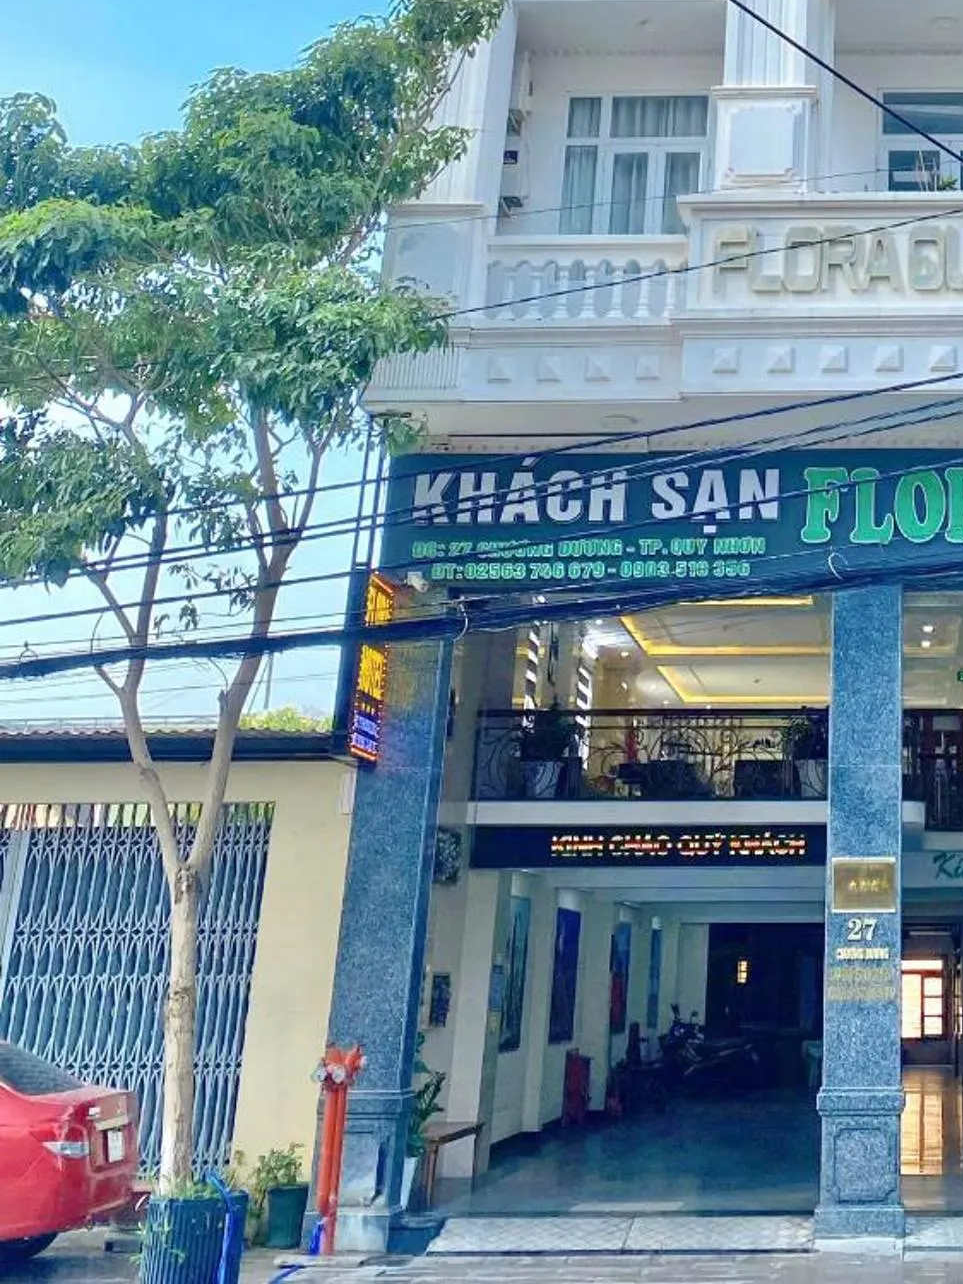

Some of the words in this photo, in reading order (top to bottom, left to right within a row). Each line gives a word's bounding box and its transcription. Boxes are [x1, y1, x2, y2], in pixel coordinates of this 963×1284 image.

[412, 457, 628, 524] KHÁCH
[651, 468, 780, 534] SẠN
[568, 561, 606, 580] 679
[847, 917, 877, 941] 27
